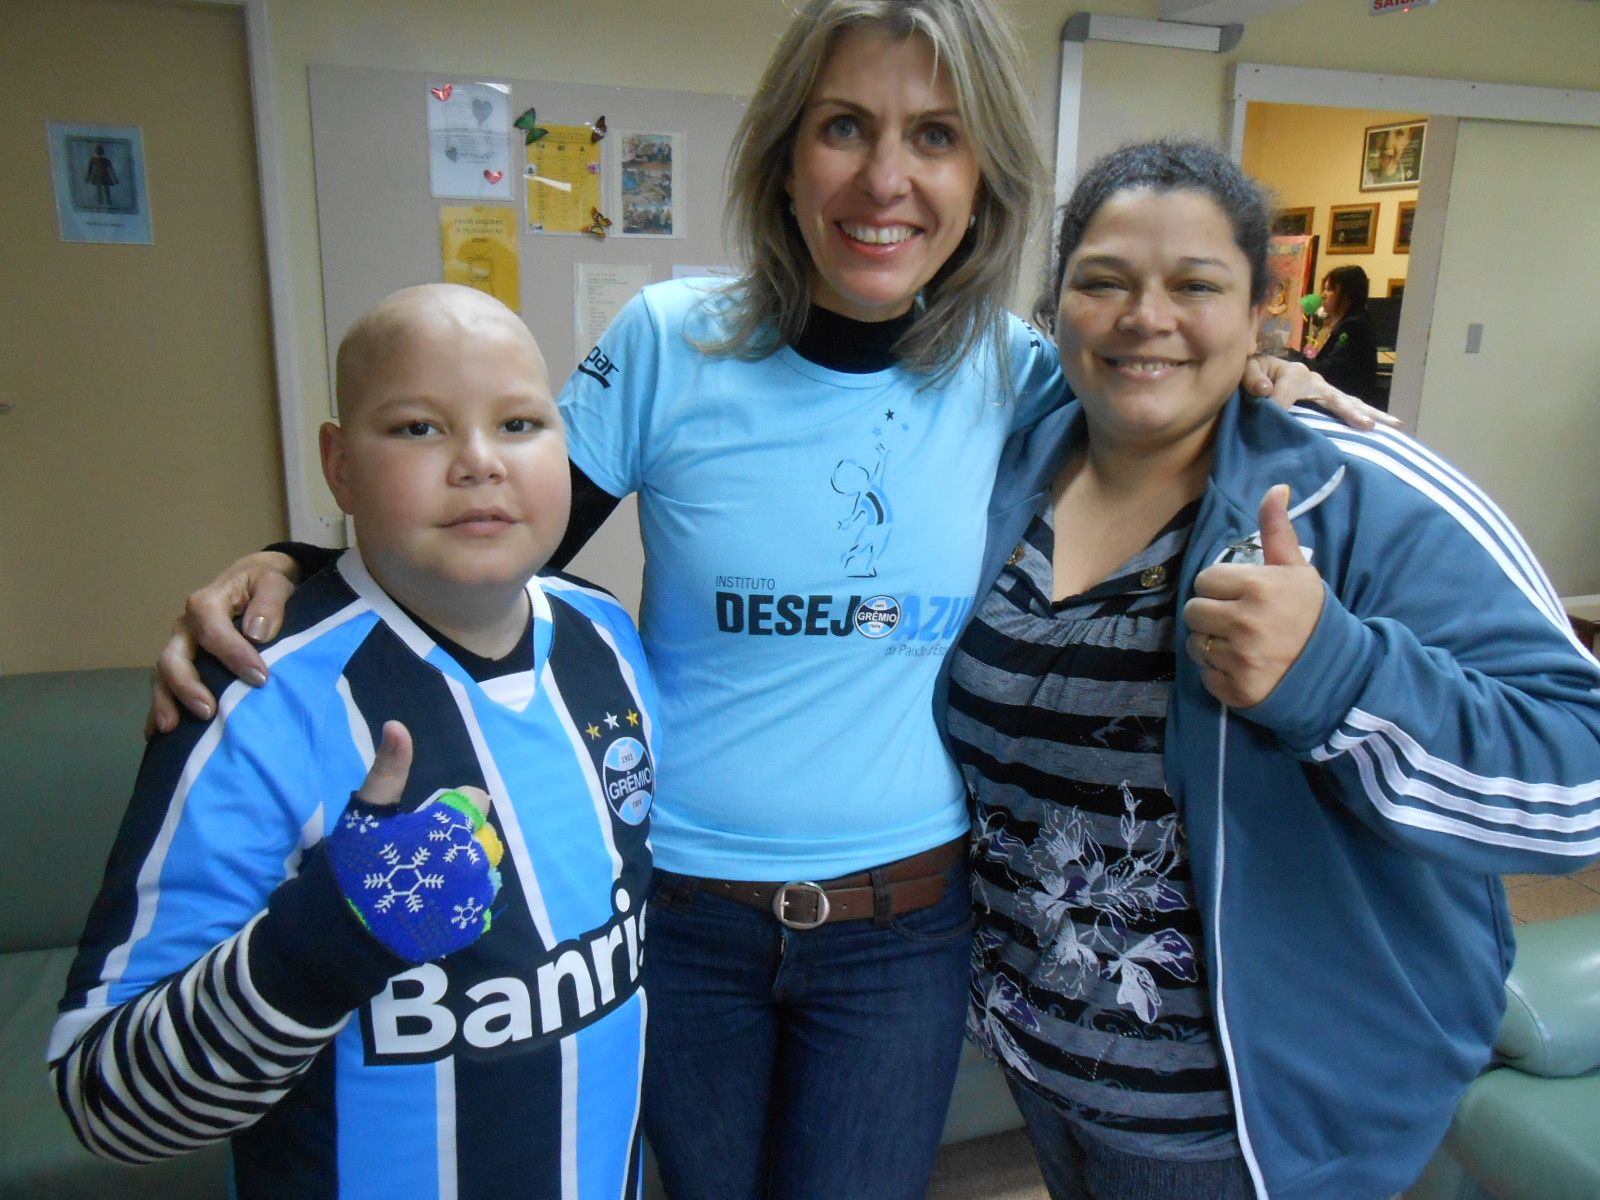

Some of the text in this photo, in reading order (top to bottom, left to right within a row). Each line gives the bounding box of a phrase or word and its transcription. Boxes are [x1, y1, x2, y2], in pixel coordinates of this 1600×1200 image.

[716, 576, 775, 590] INSTITUTO
[857, 611, 897, 623] GRÊMIO
[608, 768, 652, 800] GRÊMIO
